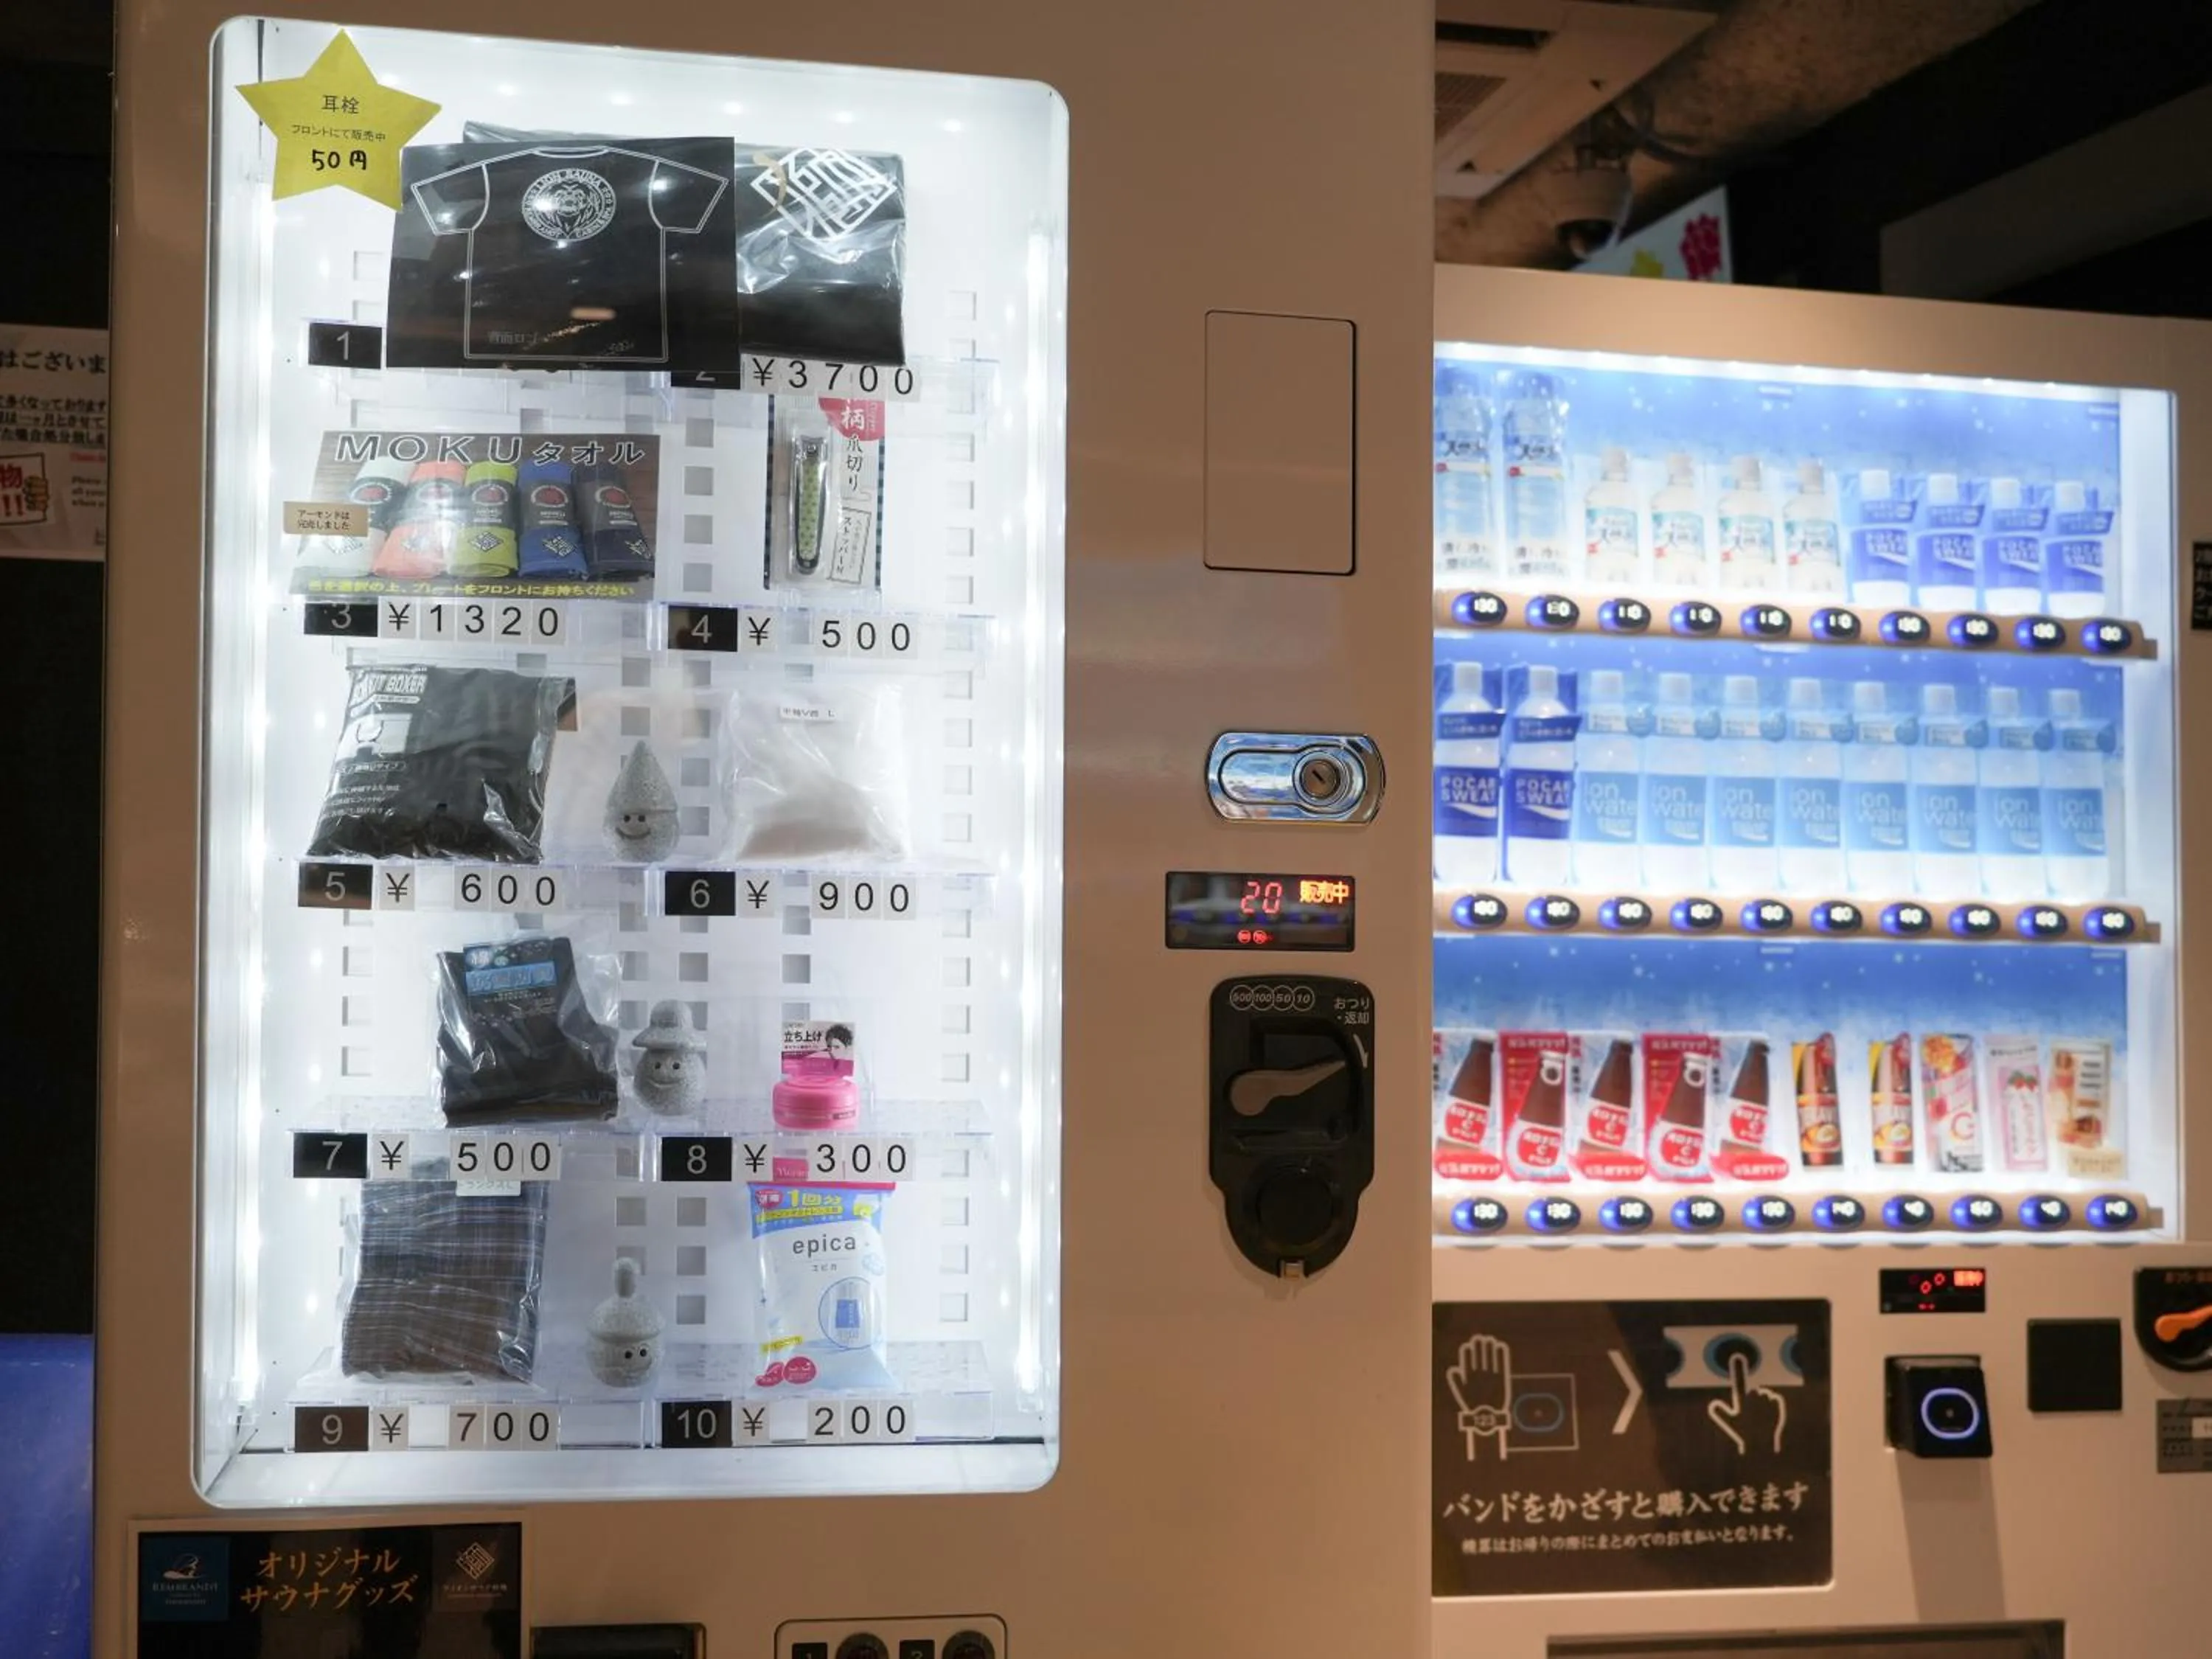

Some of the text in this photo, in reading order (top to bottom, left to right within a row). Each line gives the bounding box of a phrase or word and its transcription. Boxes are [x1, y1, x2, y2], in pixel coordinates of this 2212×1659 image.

[321, 95, 360, 114] 耳栓
[291, 124, 386, 142] フロントにて販売中
[337, 331, 349, 360] 1
[331, 603, 352, 630] 3
[691, 615, 712, 644] 4
[821, 620, 911, 651] 500
[325, 872, 345, 901] 5
[461, 873, 555, 905] 600
[689, 879, 711, 908] 6
[819, 881, 909, 912] 900
[1241, 881, 1282, 915] 20
[1277, 993, 1292, 1004] 50
[1297, 993, 1310, 1004] 10
[1334, 997, 1370, 1009] おつり
[785, 1030, 822, 1043] 立ち上げ
[322, 1141, 343, 1170] 7
[456, 1142, 551, 1172] 500
[686, 1144, 707, 1175] 8
[816, 1144, 906, 1173] 300
[793, 1234, 856, 1257] epica
[321, 1414, 343, 1444] 9
[456, 1411, 550, 1442] 700
[677, 1408, 717, 1439] 10
[814, 1405, 905, 1436] 200
[1443, 1481, 1808, 1523] バンドをかざすと購入できます
[258, 1547, 402, 1579] オリジナル
[240, 1575, 421, 1613] サウナグッズ
